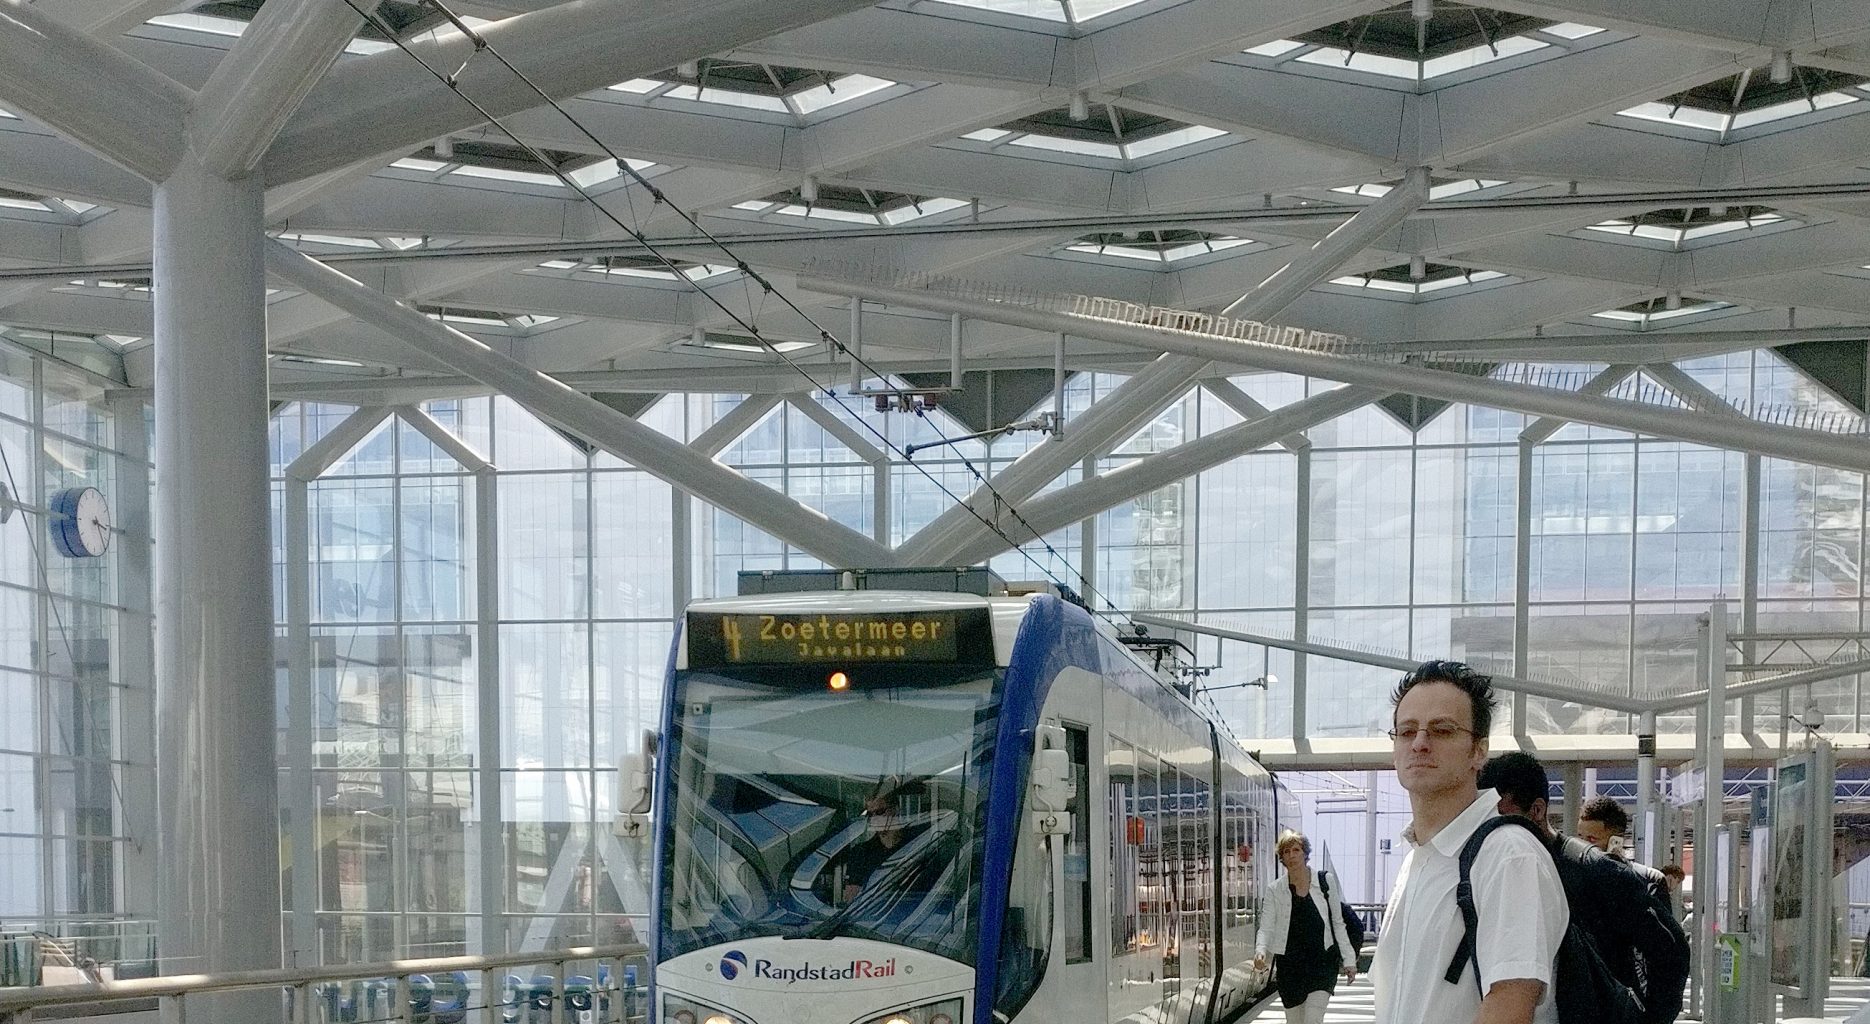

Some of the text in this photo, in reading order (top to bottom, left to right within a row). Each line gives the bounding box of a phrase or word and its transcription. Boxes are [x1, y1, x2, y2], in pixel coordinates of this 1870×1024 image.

[722, 614, 941, 660] 4 Zoetermeer
[754, 957, 896, 985] RandstadRail
